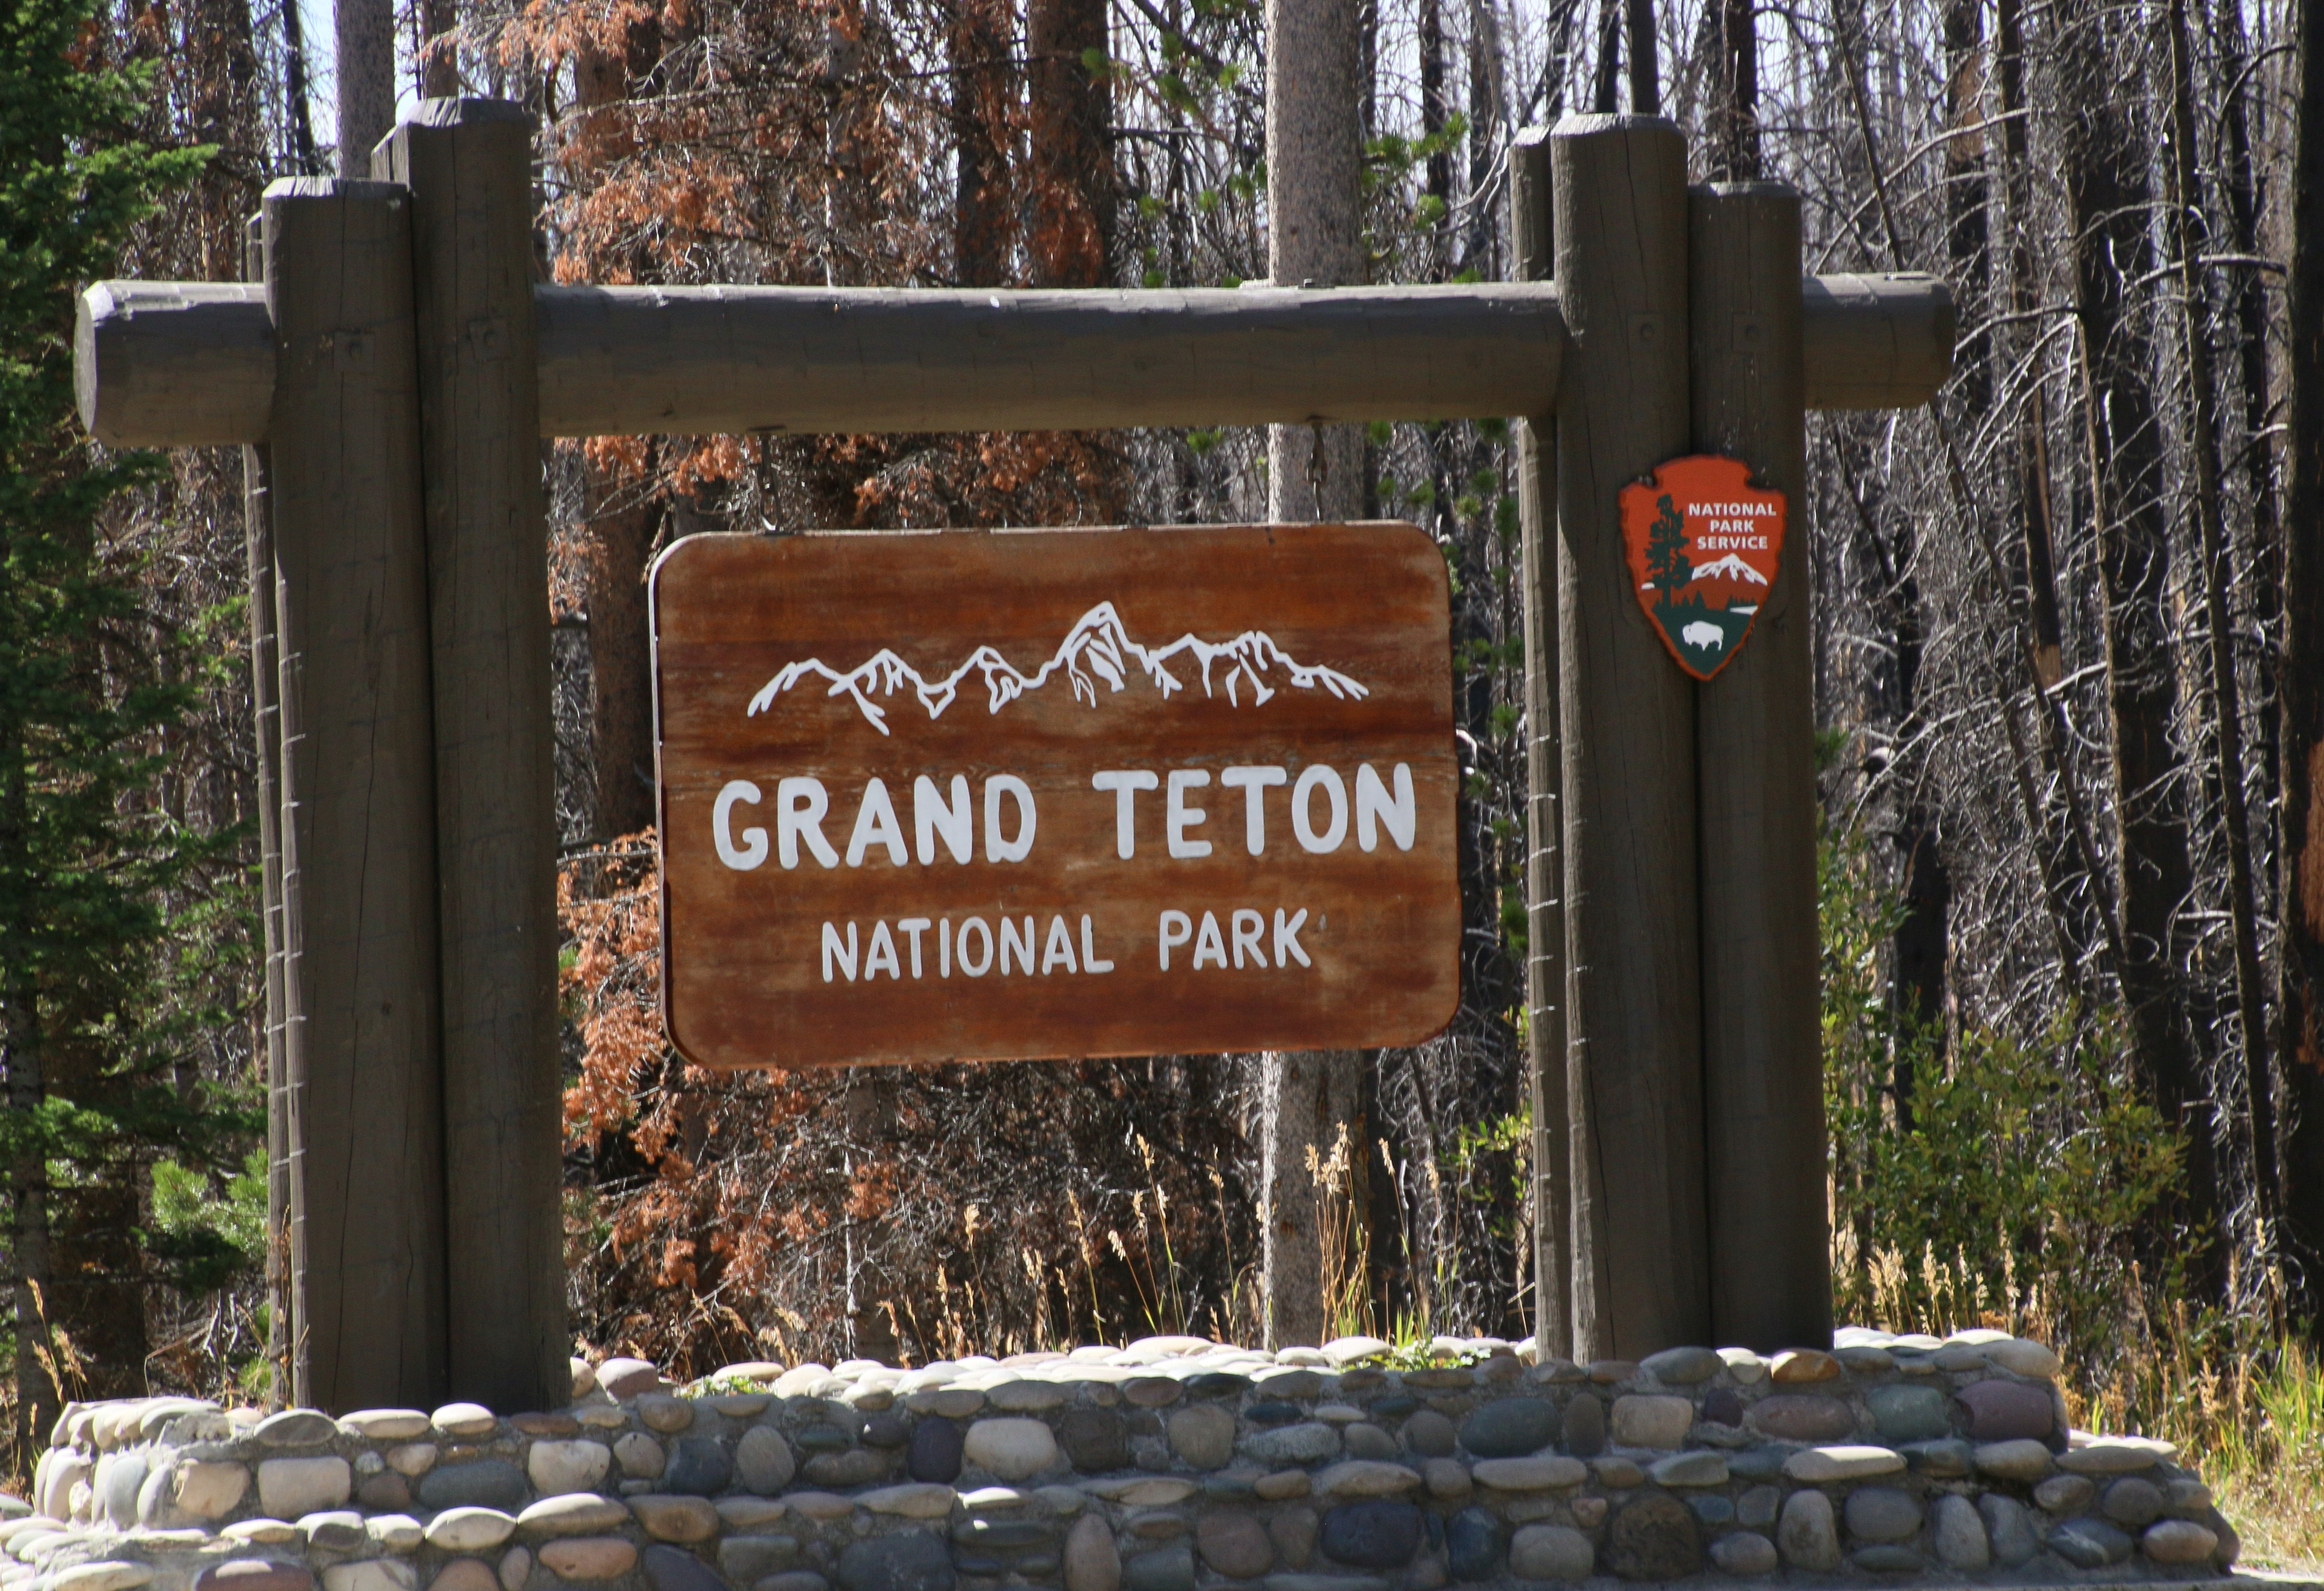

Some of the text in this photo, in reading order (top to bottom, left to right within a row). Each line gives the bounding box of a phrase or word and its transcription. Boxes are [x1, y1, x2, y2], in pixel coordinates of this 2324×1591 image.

[1688, 502, 1777, 516] NATIONAL
[1710, 519, 1754, 533] PARK
[1697, 536, 1768, 550] SERVICE
[713, 763, 1416, 870] GRAND TETON
[822, 907, 1311, 983] NATIONAL PARK
